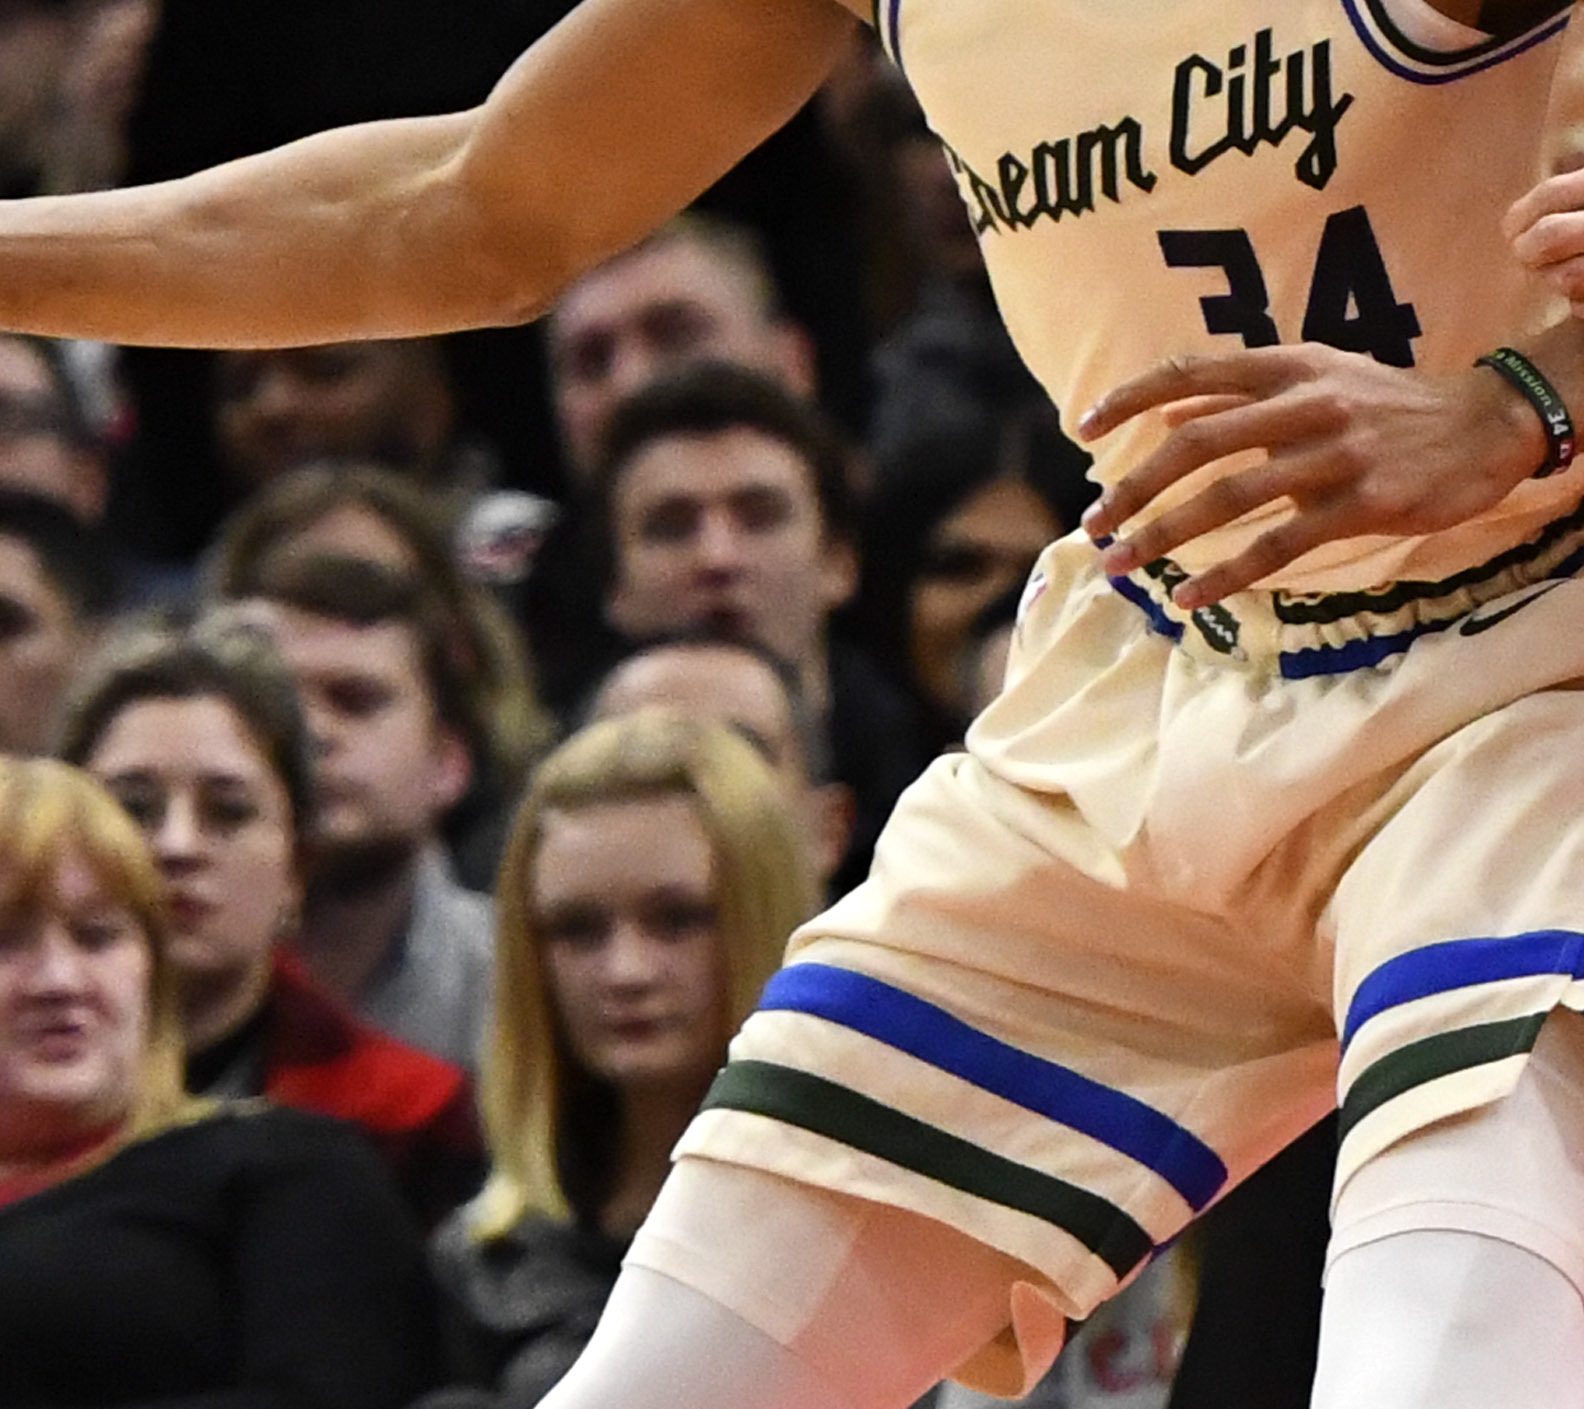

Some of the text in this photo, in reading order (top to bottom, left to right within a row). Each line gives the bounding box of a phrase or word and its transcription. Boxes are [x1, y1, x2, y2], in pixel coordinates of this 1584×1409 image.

[1170, 27, 1355, 191] City
[1156, 204, 1423, 369] 34
[1547, 408, 1569, 435] 34
